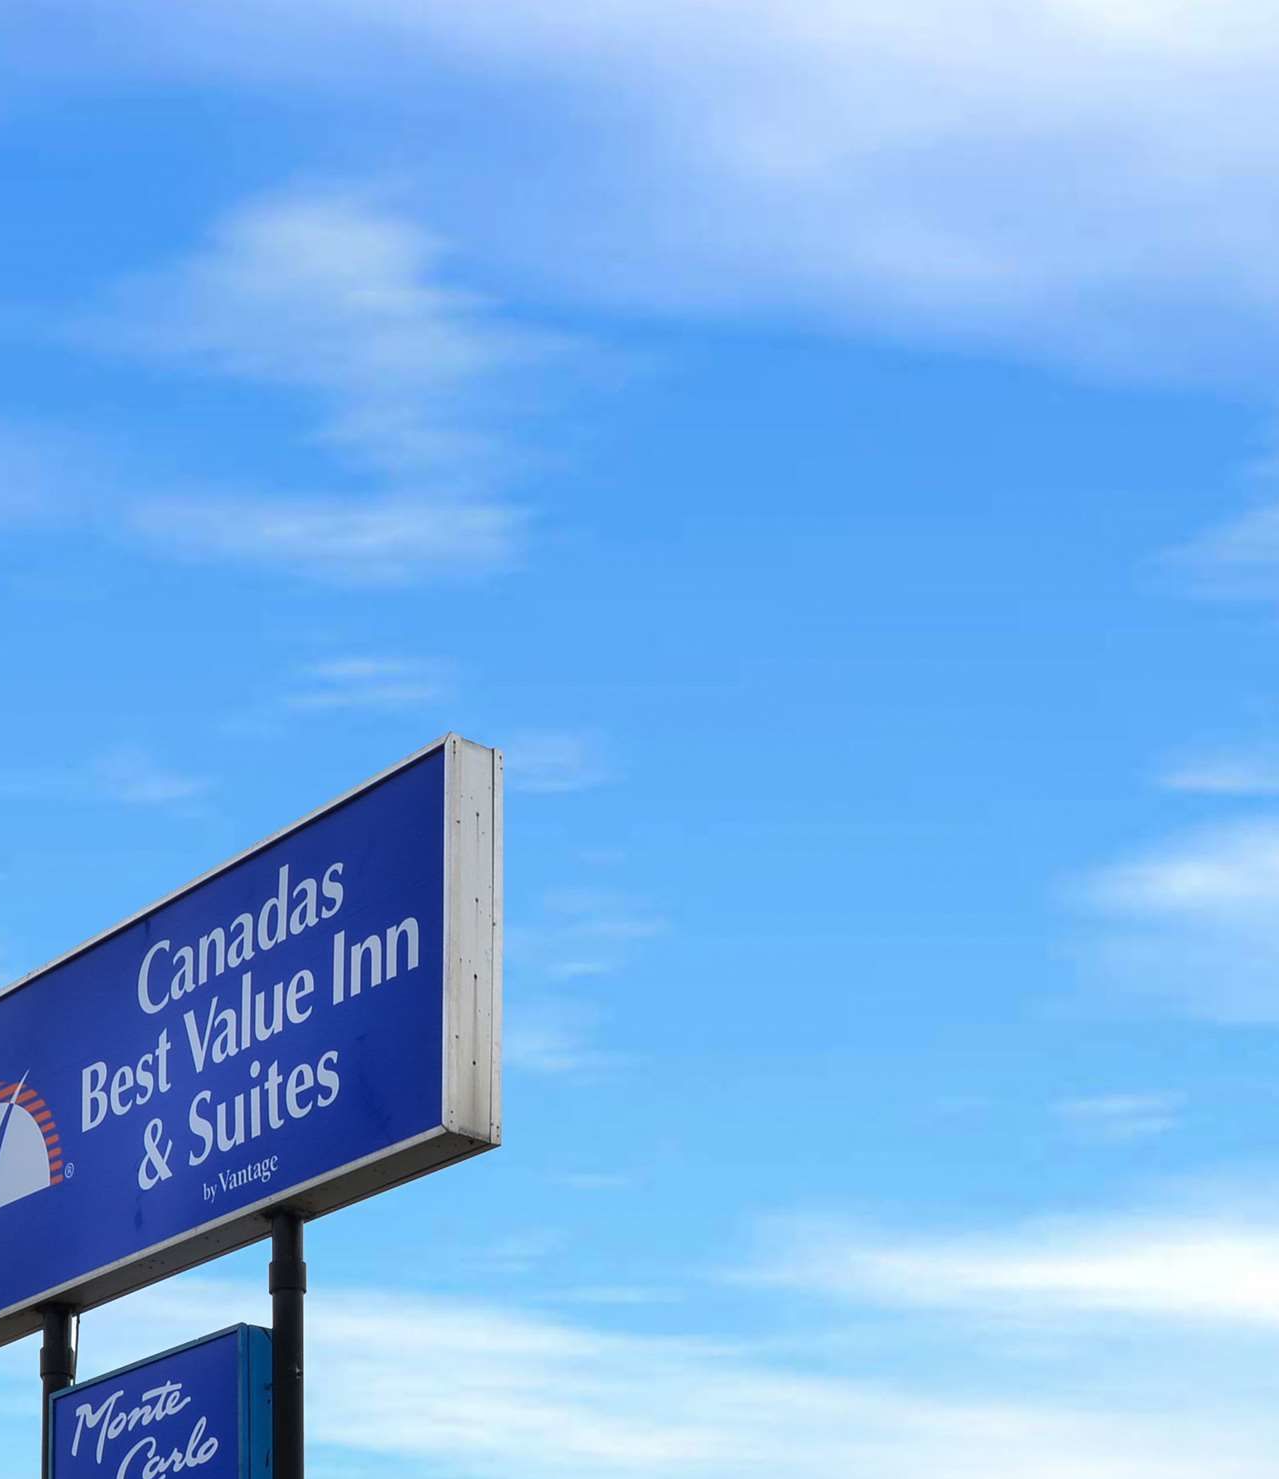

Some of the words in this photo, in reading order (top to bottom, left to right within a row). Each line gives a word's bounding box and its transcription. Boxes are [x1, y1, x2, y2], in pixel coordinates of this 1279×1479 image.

[138, 862, 344, 1015] Canadas
[81, 1027, 171, 1133] Best
[183, 969, 315, 1074] Value
[333, 916, 420, 1006] Inn
[138, 1117, 173, 1191] &
[188, 1050, 341, 1168] Suites
[203, 1183, 218, 1204] by
[218, 1155, 279, 1193] Vantage
[71, 1380, 191, 1464] Monte
